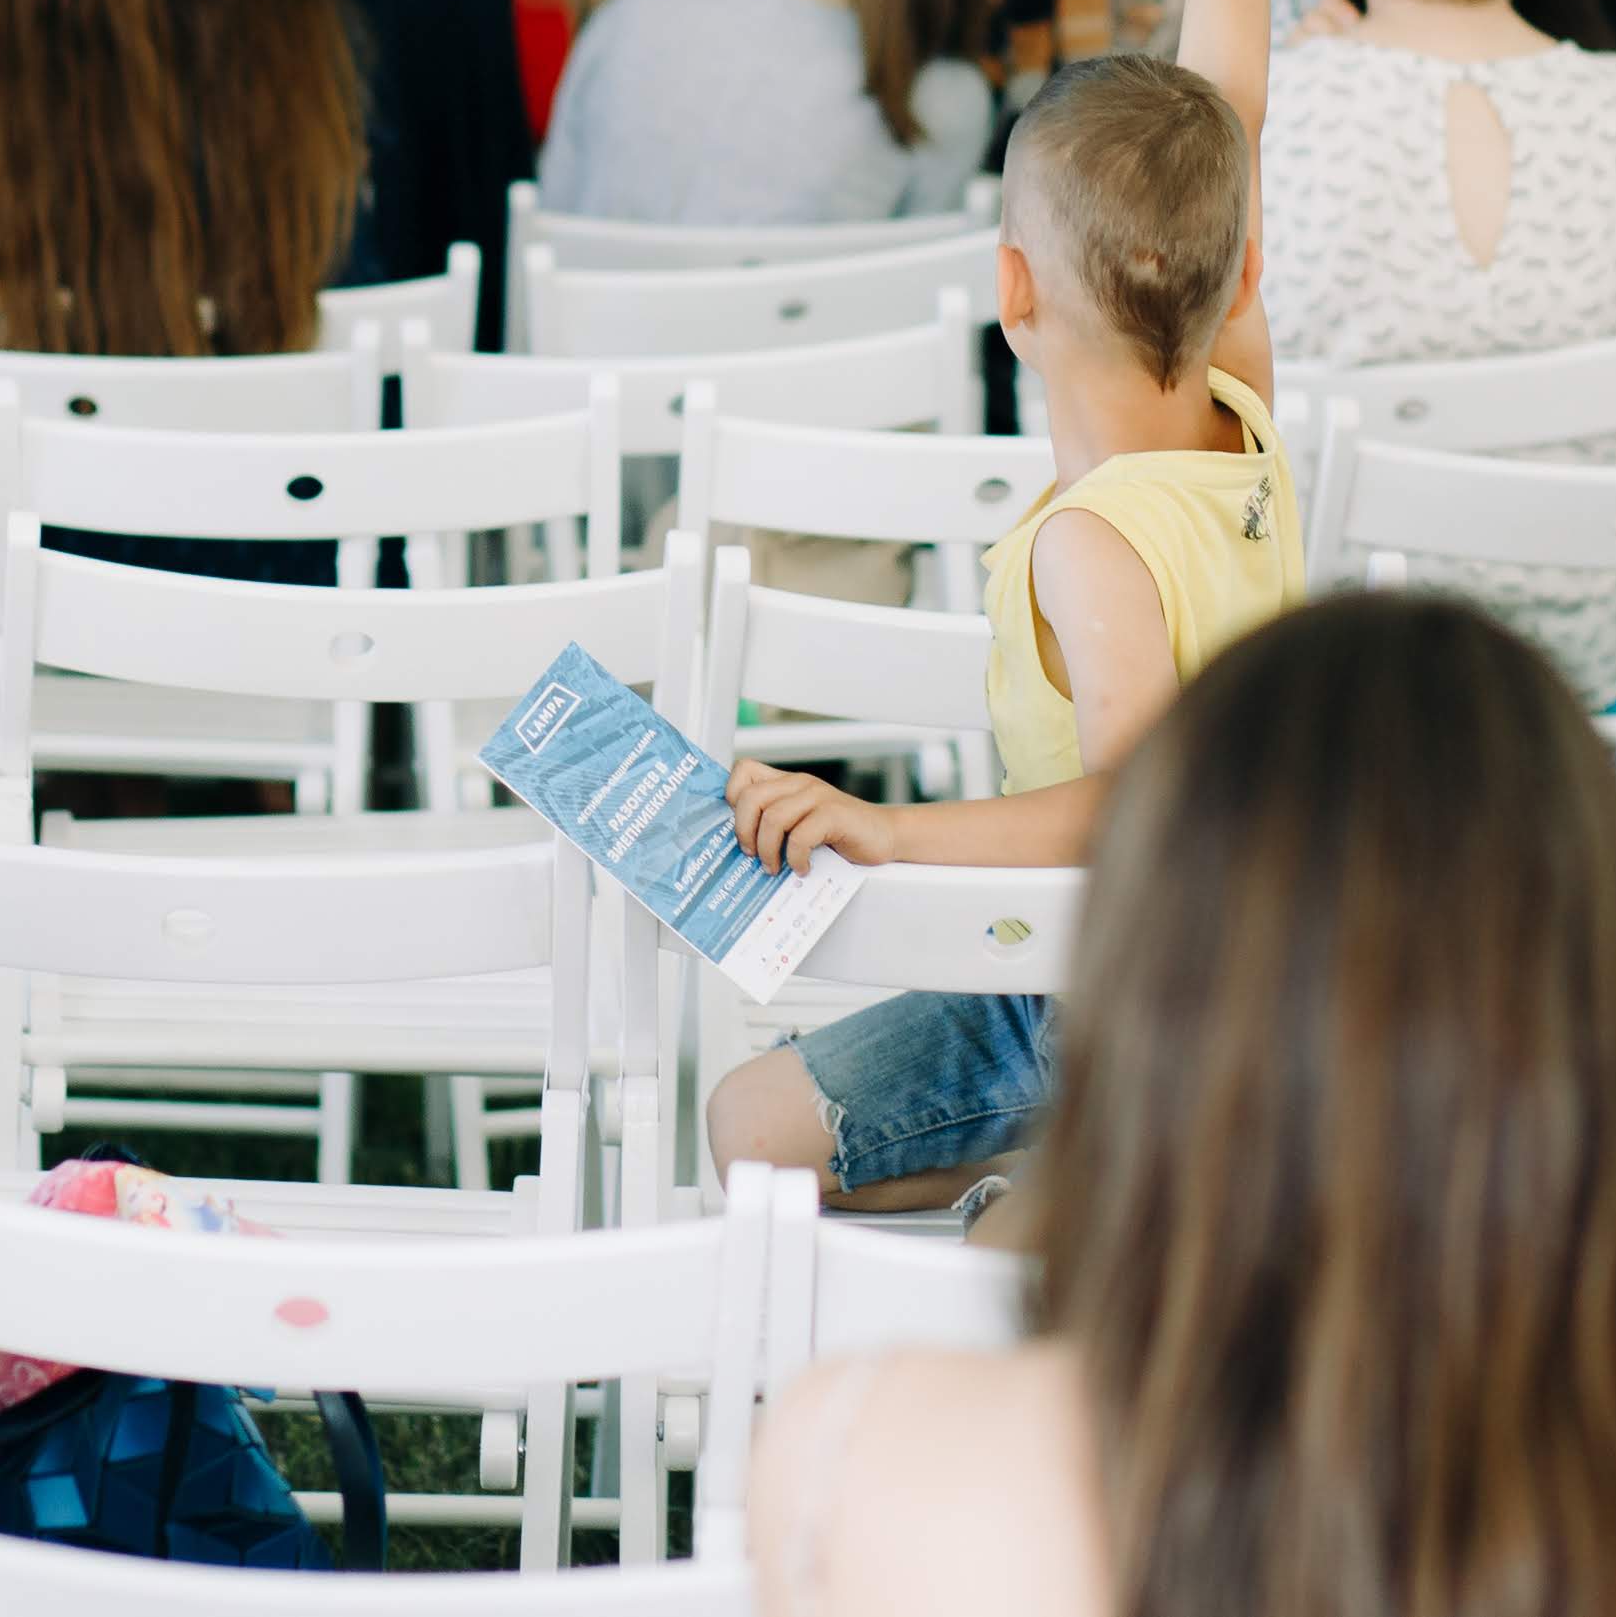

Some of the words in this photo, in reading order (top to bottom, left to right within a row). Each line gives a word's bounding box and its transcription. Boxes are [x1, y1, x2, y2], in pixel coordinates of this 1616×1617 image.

[524, 691, 567, 740] LAMPA
[604, 750, 701, 865] ЗИЕПНИЕККАЛНСЕ
[606, 768, 663, 833] РАЗОГРЕВ
[653, 758, 670, 775] В
[708, 832, 724, 848] 26
[706, 887, 729, 912] ВХОД
[722, 853, 756, 892] СВОБОДН
